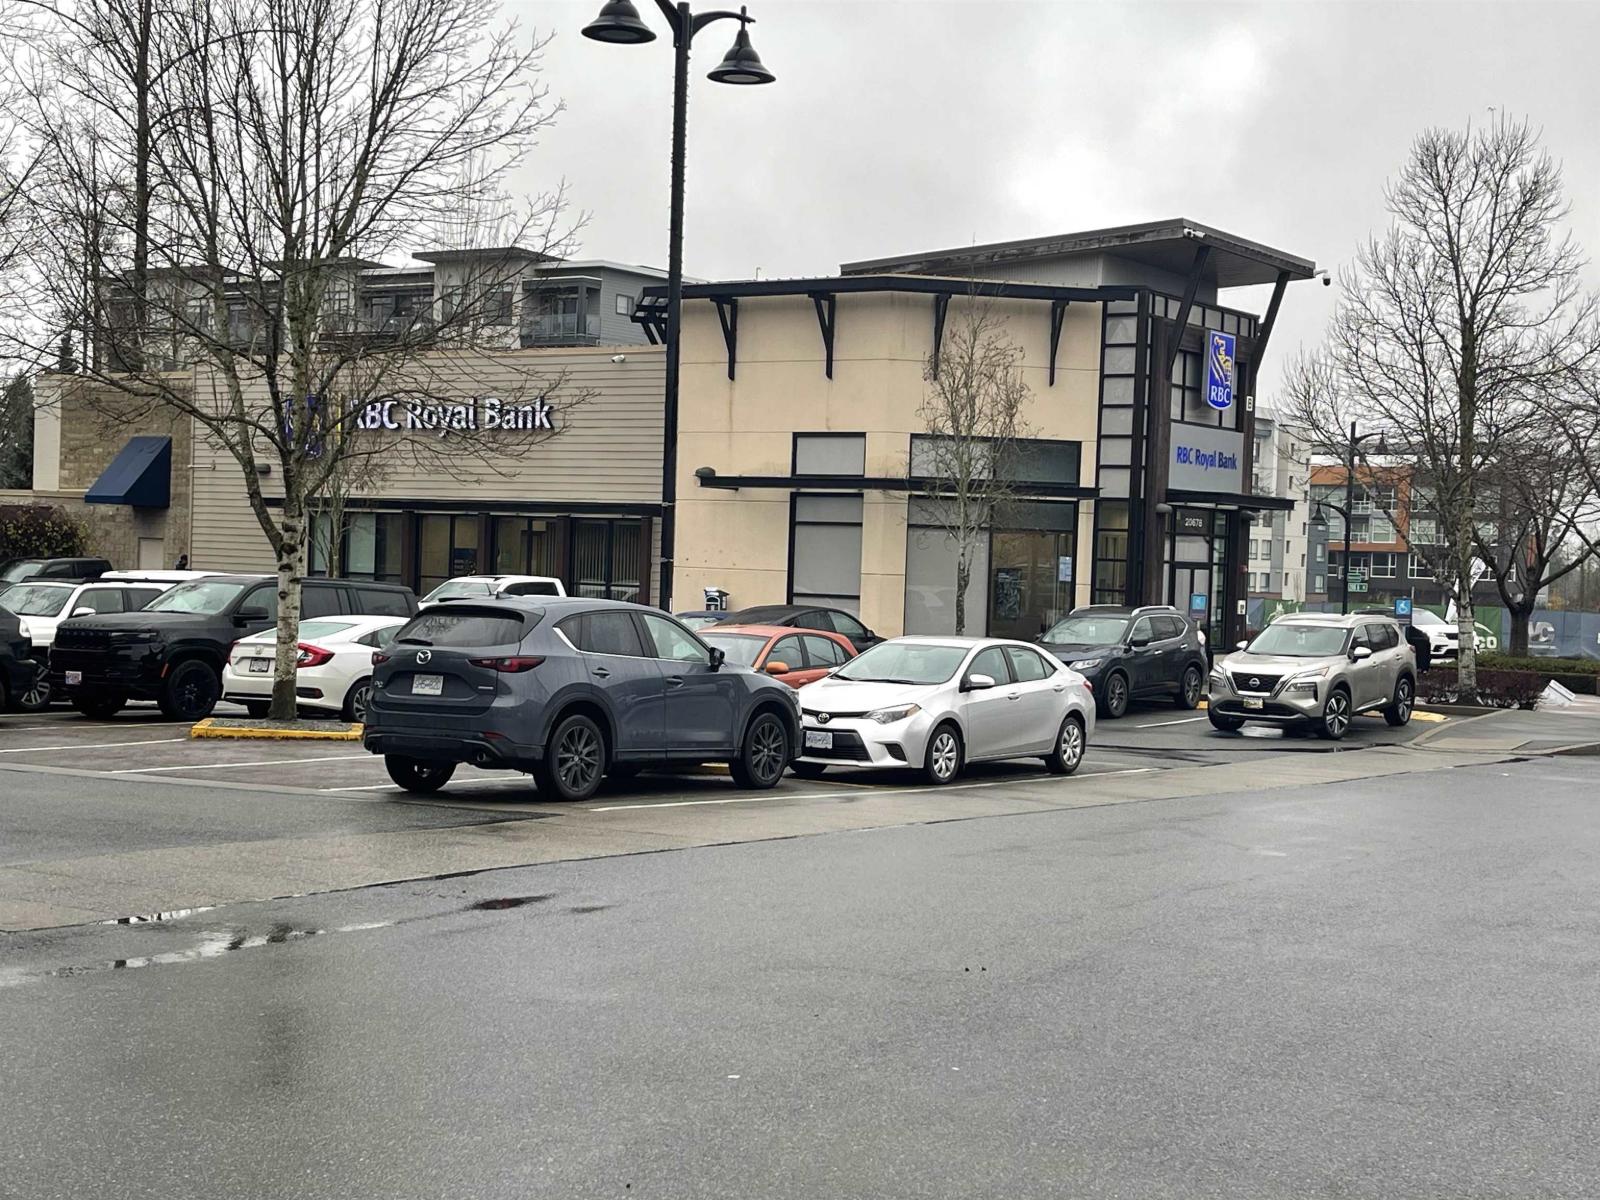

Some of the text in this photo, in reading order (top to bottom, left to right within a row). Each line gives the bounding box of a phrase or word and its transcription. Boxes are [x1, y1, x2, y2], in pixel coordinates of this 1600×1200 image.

[1210, 386, 1230, 403] RBC
[407, 398, 476, 437] Royal
[484, 397, 552, 429] Bank
[1176, 446, 1237, 470] RBC Royal Bank
